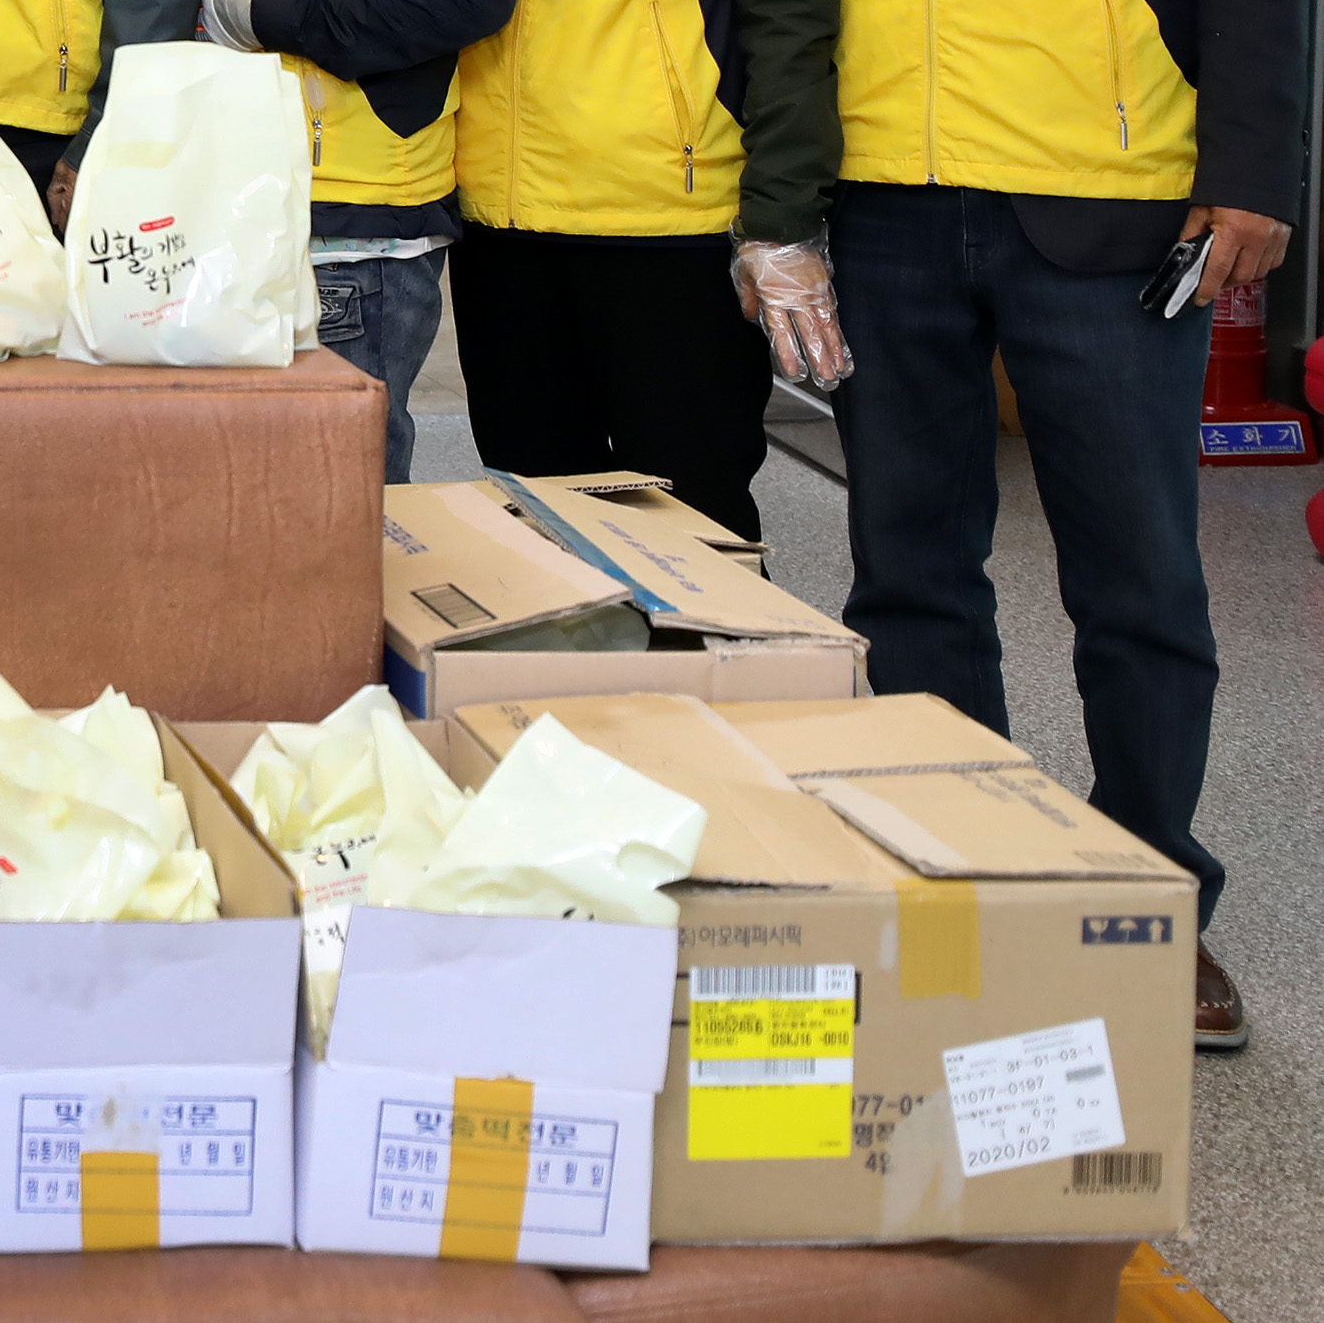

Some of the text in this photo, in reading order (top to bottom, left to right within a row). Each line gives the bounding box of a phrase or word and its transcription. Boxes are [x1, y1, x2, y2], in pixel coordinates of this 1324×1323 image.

[88, 227, 153, 283] 부활의
[1207, 425, 1297, 445] 소화기
[56, 1103, 217, 1127] 맞전문
[967, 1137, 1050, 1167] 2020/02
